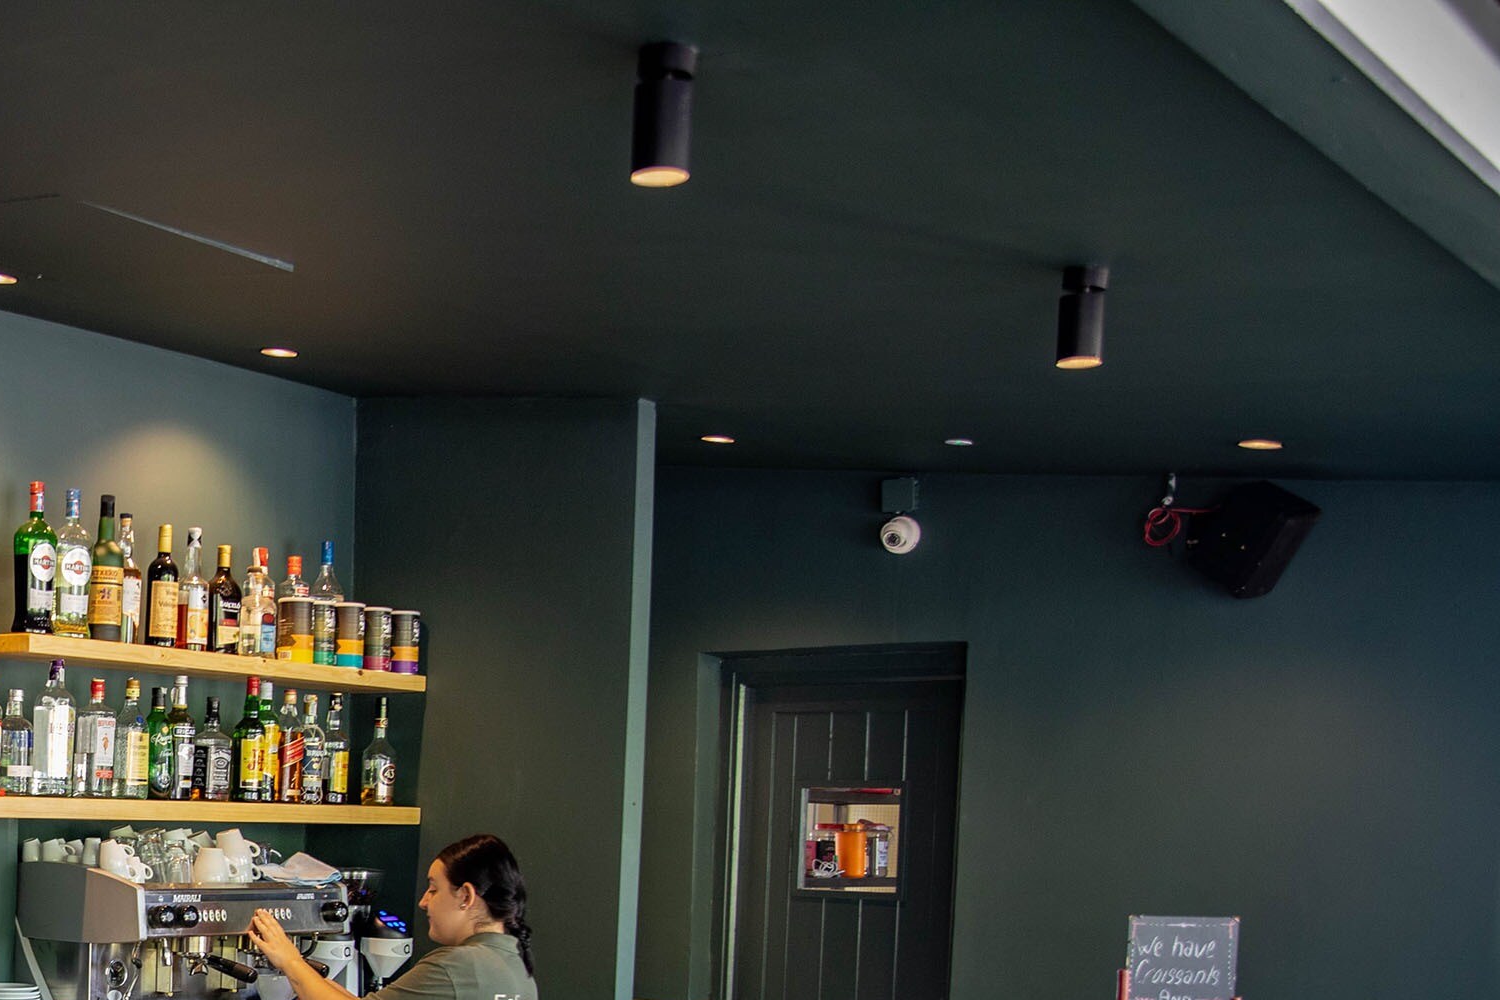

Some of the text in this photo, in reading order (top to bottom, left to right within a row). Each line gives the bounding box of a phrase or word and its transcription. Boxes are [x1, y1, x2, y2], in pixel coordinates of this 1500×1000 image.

[1136, 935, 1216, 958] We have
[1135, 959, 1220, 986] Croissants
